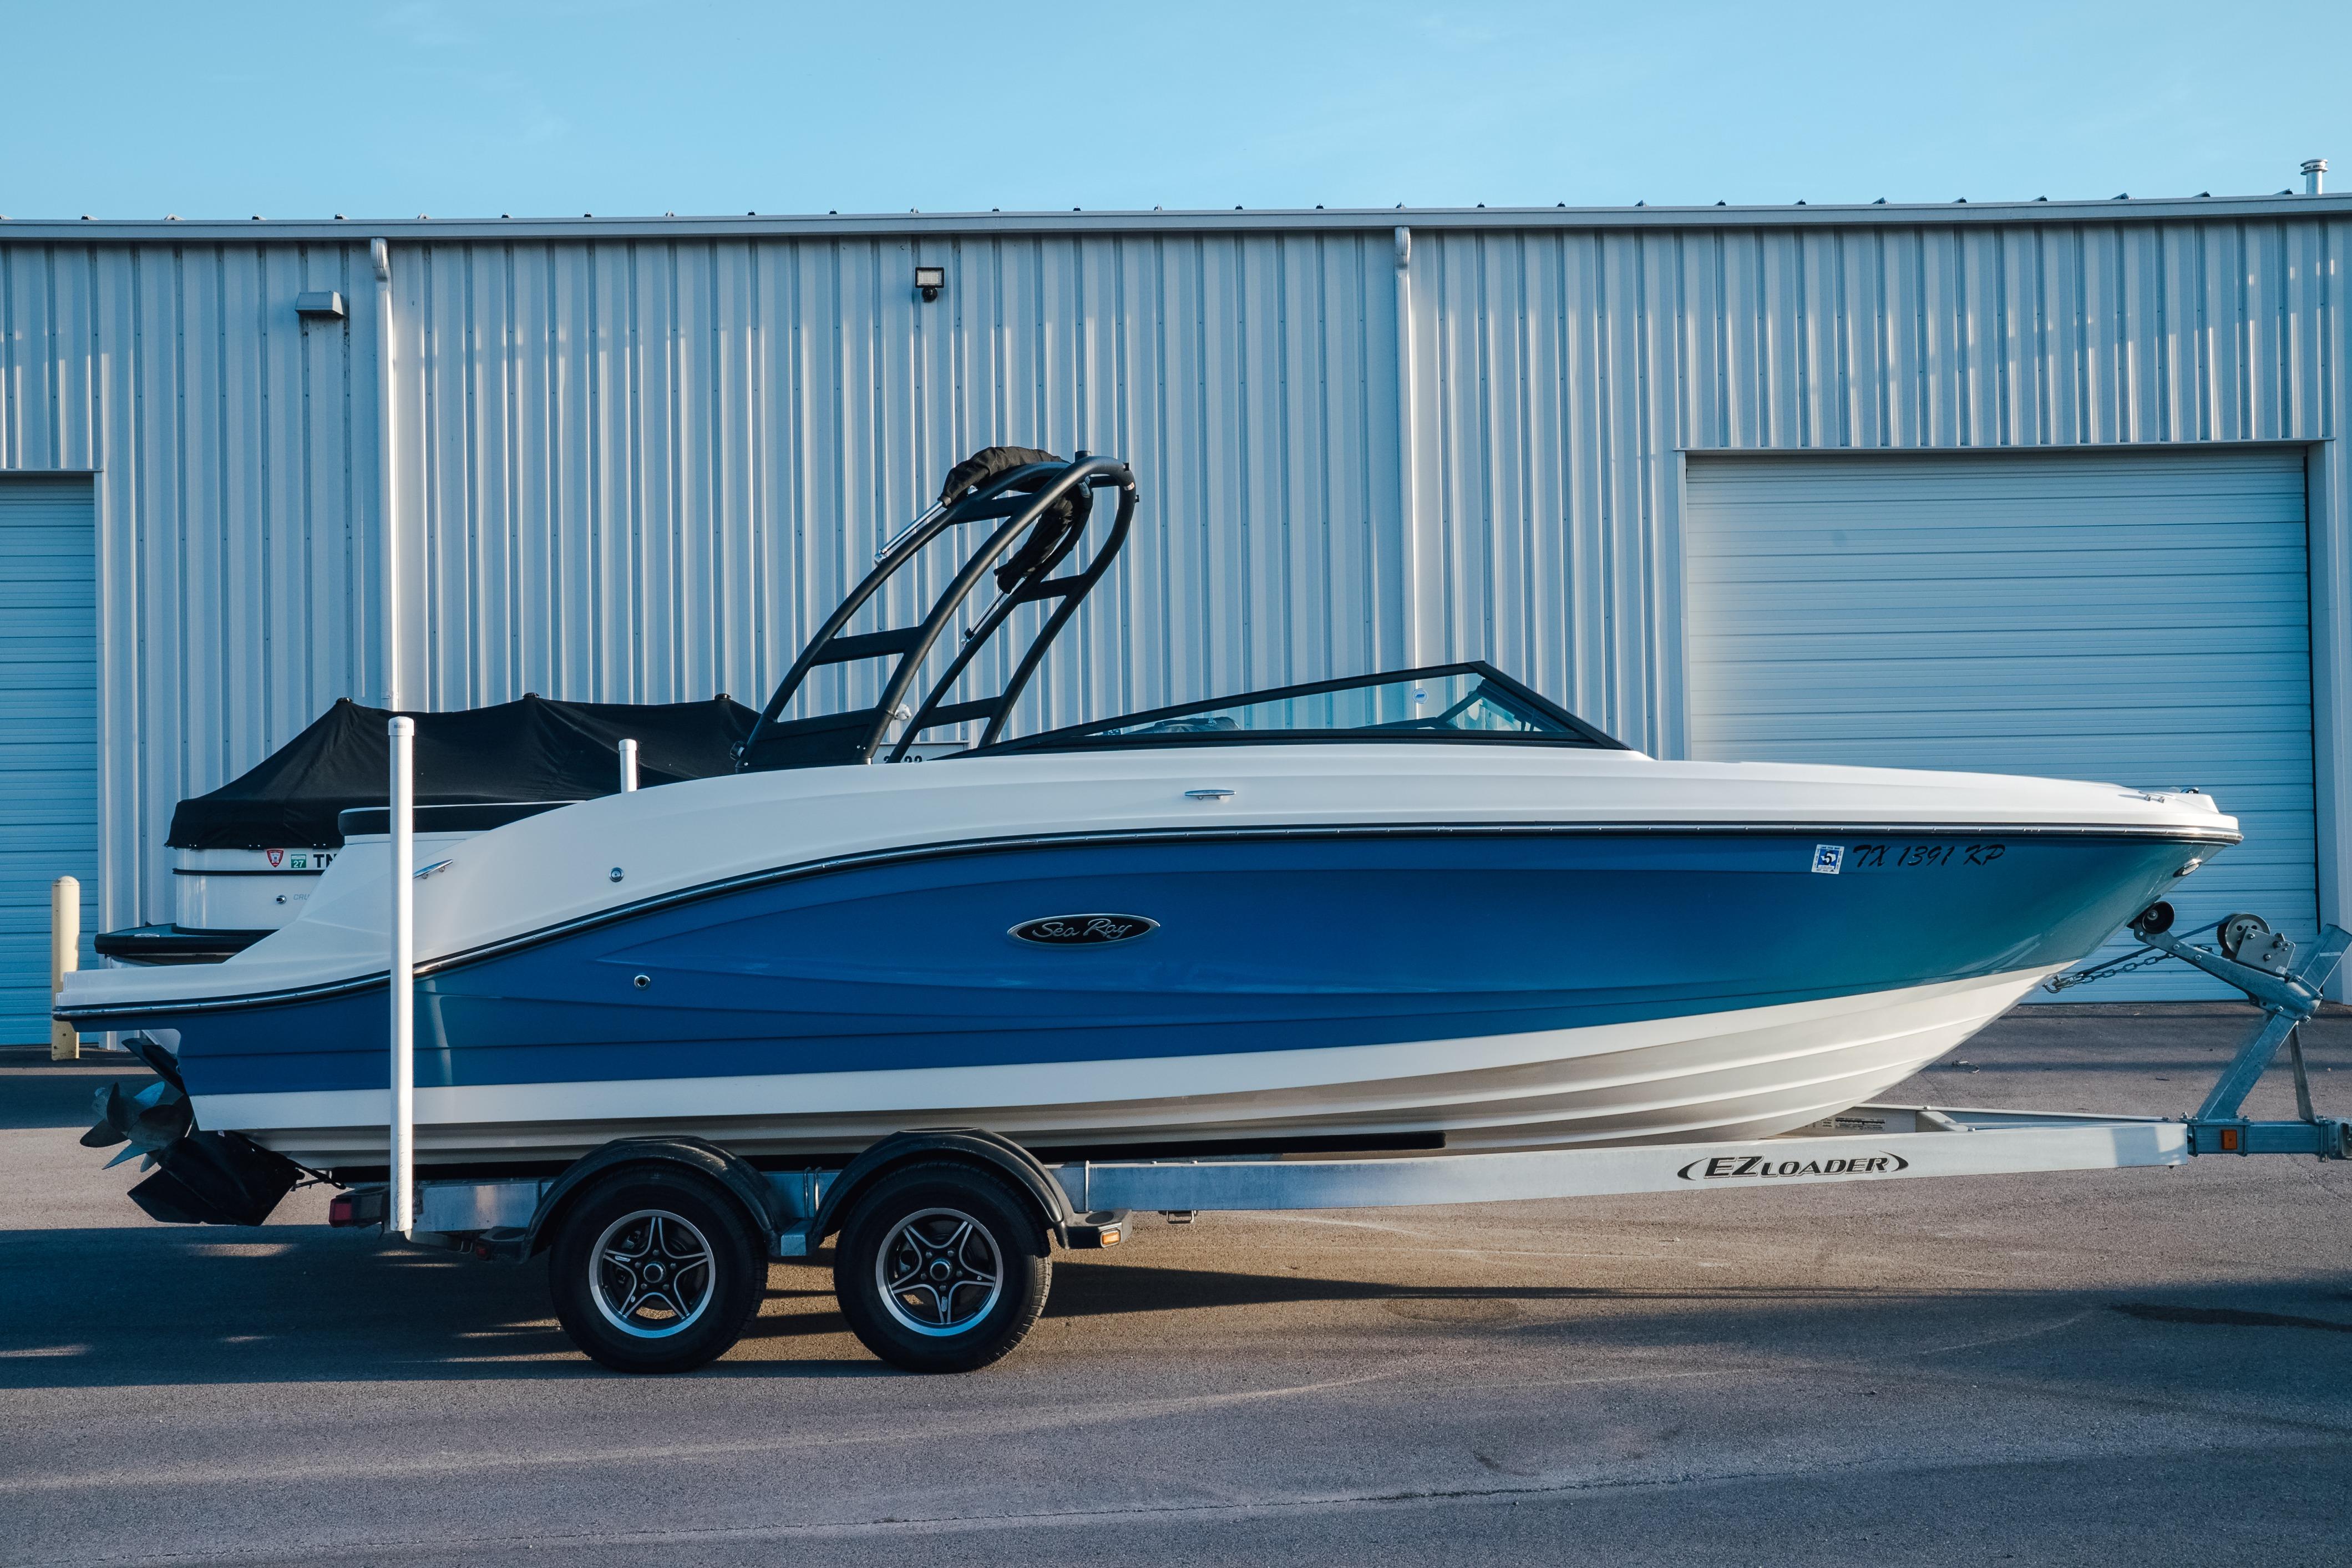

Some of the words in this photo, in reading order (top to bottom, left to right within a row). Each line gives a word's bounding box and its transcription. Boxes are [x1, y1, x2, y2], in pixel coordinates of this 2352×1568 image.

[293, 860, 304, 868] 27
[1853, 844, 1890, 867] TX
[1897, 845, 1955, 866] 1391
[1963, 844, 2005, 866] KP
[1032, 922, 1080, 938] Sea
[1083, 918, 1132, 940] Ray
